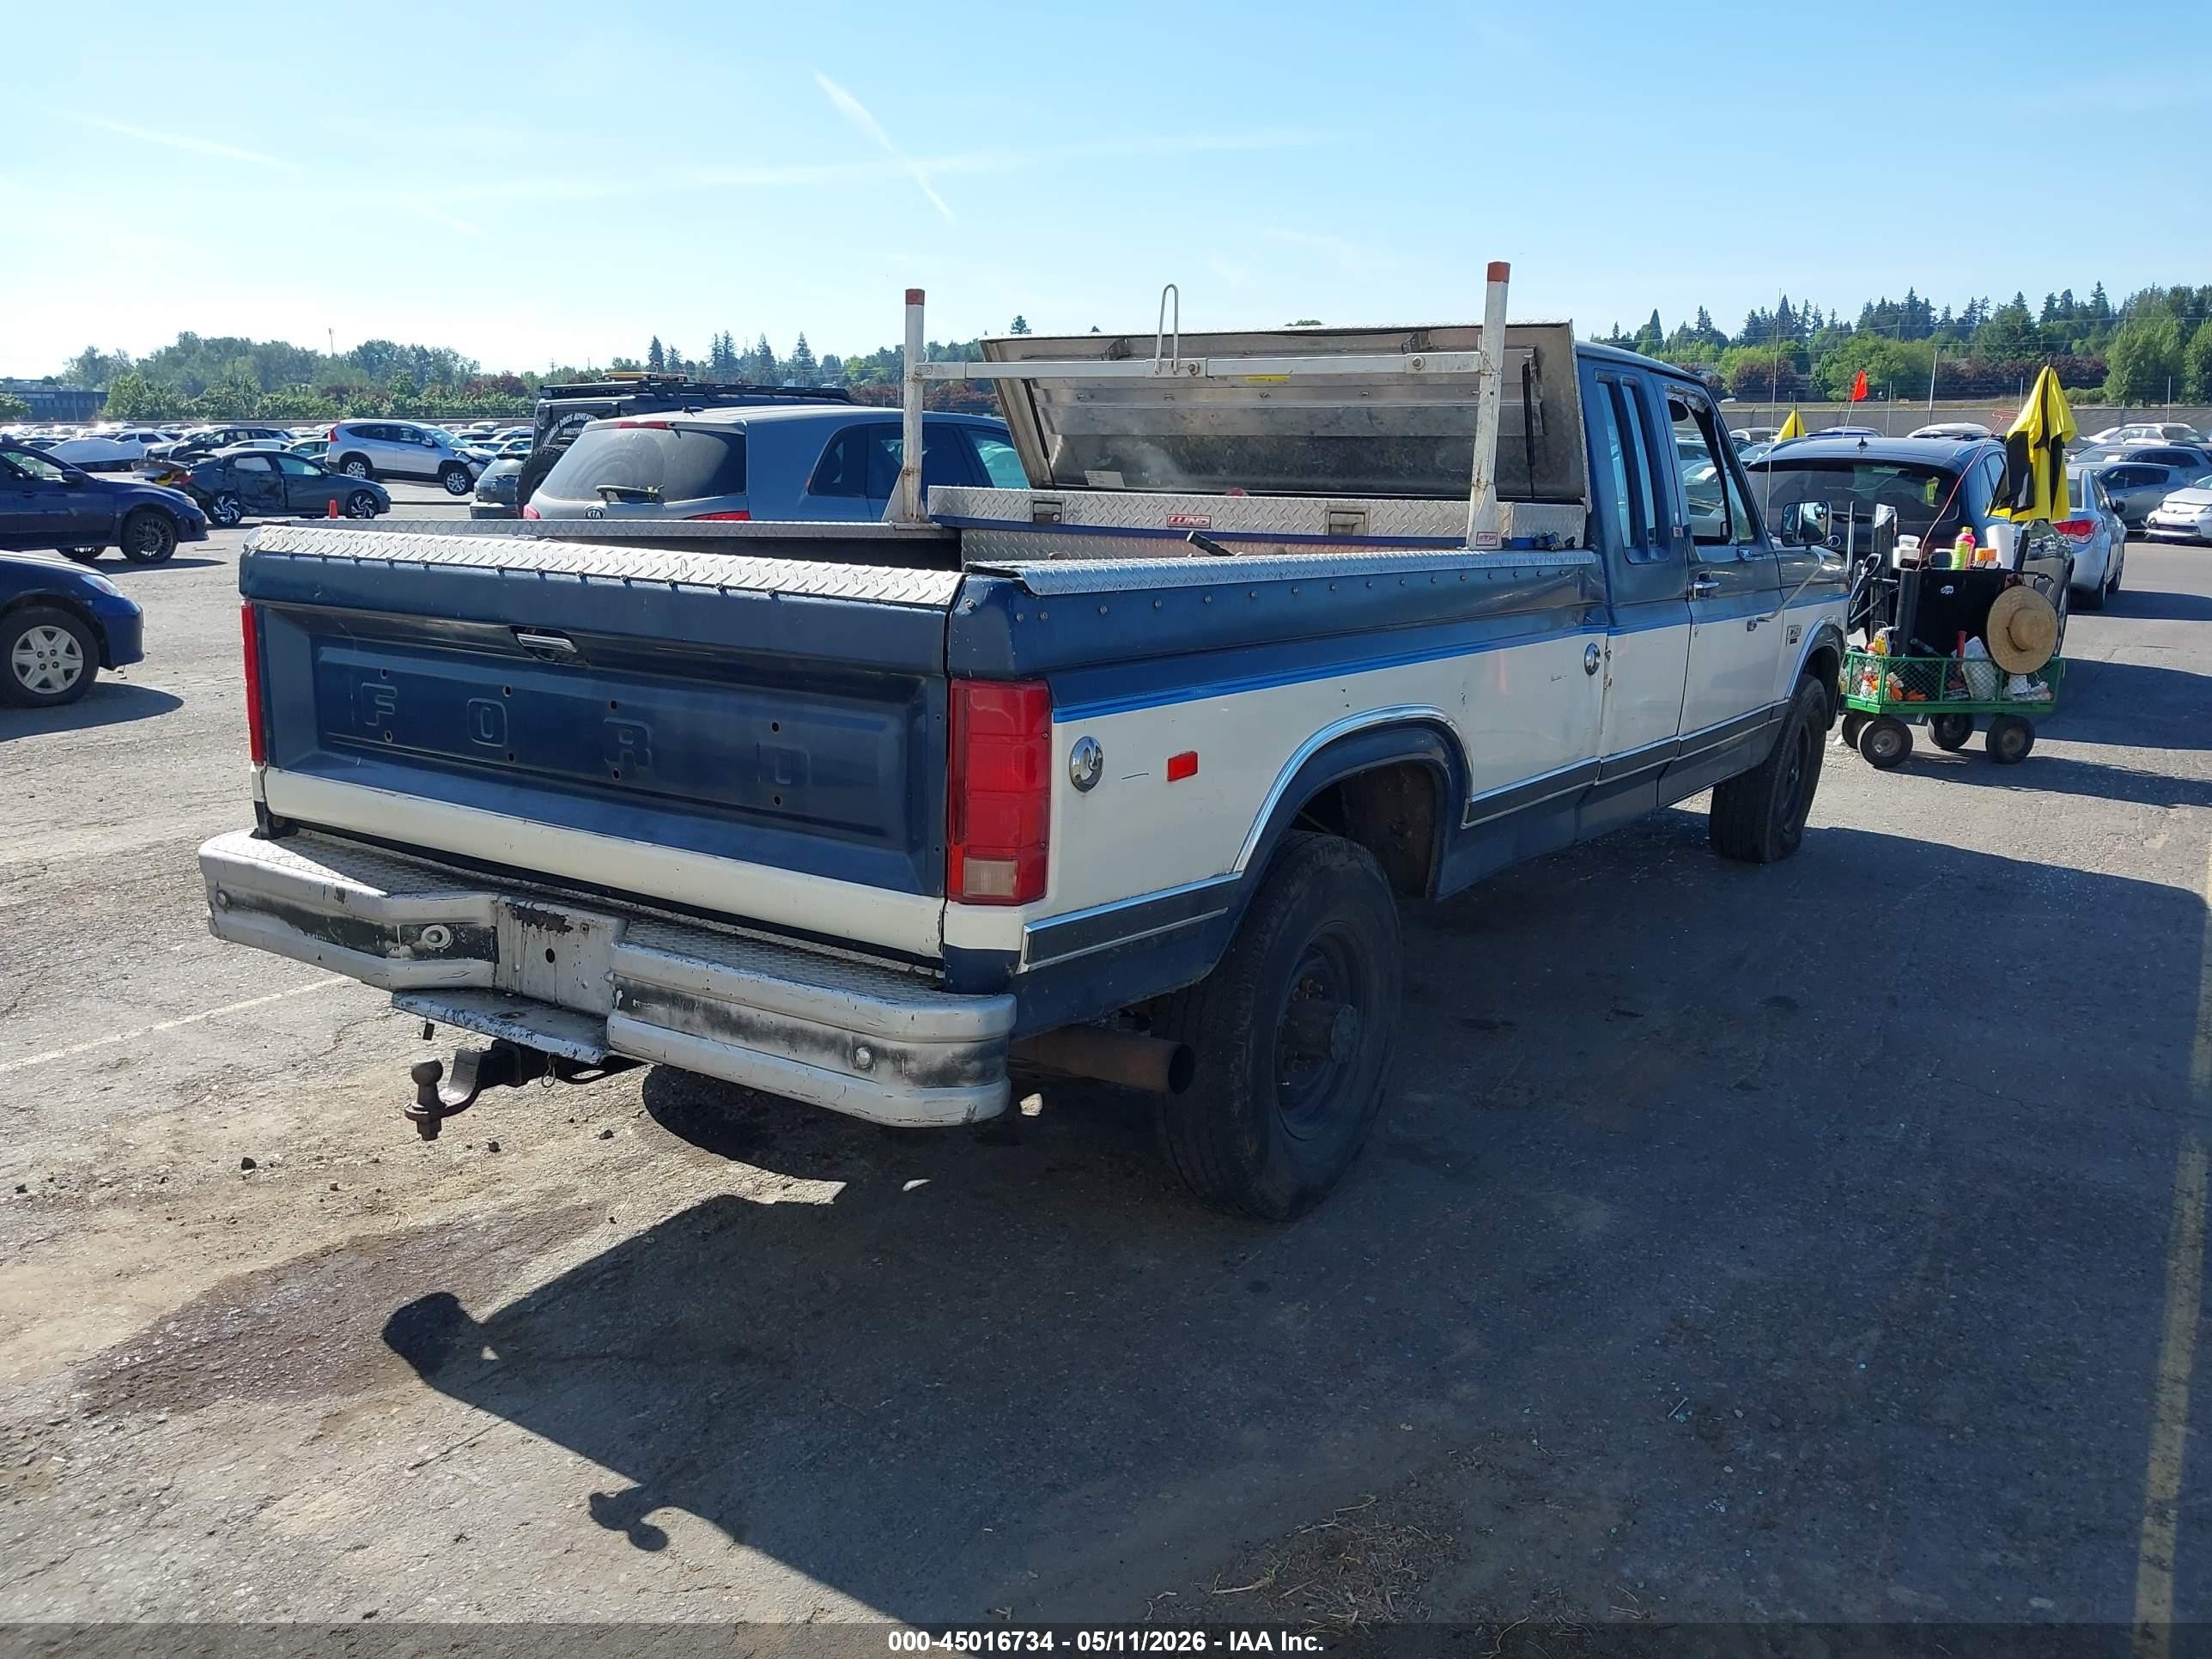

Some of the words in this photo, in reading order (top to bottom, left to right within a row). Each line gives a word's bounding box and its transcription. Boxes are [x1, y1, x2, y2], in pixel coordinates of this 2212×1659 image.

[559, 413, 574, 428] DOGS
[587, 509, 602, 520] KIA
[1170, 517, 1209, 526] LUND
[361, 682, 811, 792] FORD
